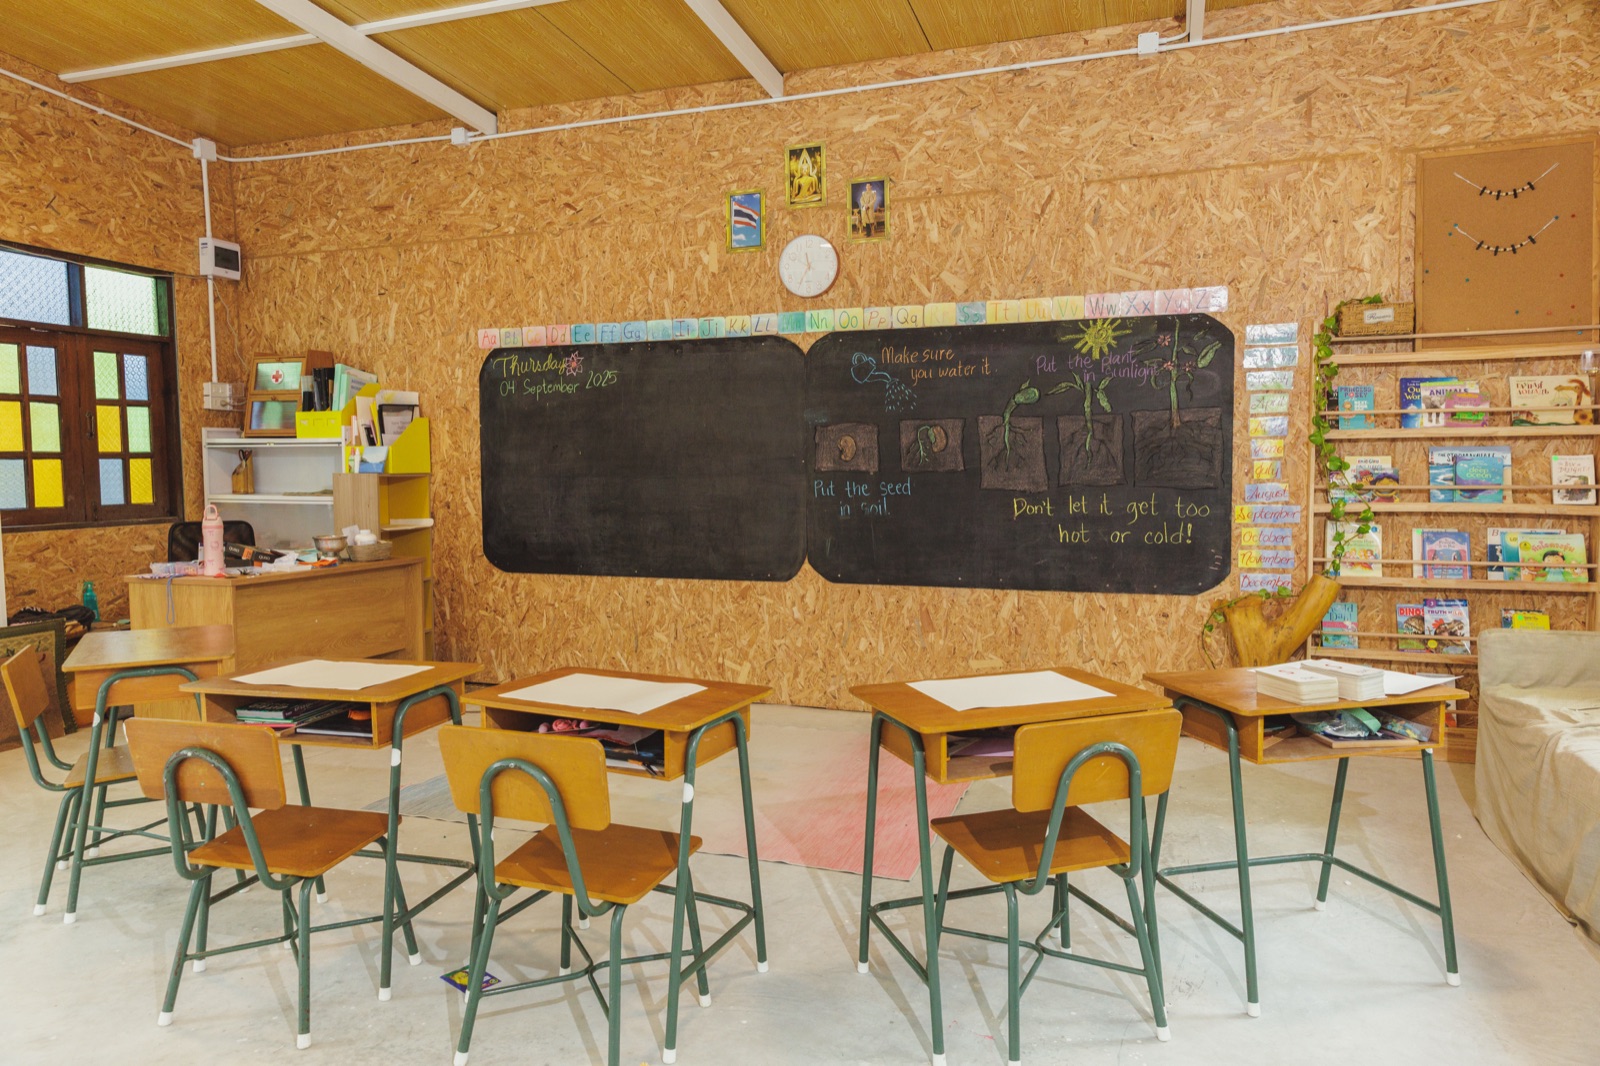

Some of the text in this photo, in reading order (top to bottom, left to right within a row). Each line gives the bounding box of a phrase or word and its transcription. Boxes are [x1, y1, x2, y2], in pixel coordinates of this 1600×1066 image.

[482, 331, 497, 345] Aa
[504, 331, 519, 344] Bb
[526, 330, 541, 344] Cc
[551, 327, 567, 343] Dd
[574, 325, 590, 342] Ee
[601, 323, 617, 342] Ff
[623, 323, 641, 341] Gg
[675, 319, 690, 337] Ii
[703, 319, 718, 337] Jj
[729, 317, 747, 334] Kk
[810, 312, 828, 329] Nn
[838, 310, 858, 329] Oo
[868, 311, 886, 328] Pp
[896, 307, 918, 328] Qq
[959, 305, 983, 323] Ss
[991, 302, 1009, 322] Tt
[1026, 301, 1046, 320] Uu
[1057, 297, 1078, 317] Vv
[1089, 296, 1117, 316] Ww
[1126, 294, 1151, 315] Xx
[1163, 291, 1183, 314] Yy
[881, 346, 955, 364] Make sure
[1036, 345, 1138, 375] Put the plant
[493, 353, 567, 378] Thursday
[910, 368, 933, 387] you
[938, 360, 976, 379] water
[500, 369, 619, 402] 04 September 2025
[1083, 370, 1096, 383] in
[1253, 440, 1283, 456] June
[1255, 461, 1279, 479] July
[814, 477, 911, 498] Put the seed
[1246, 485, 1288, 501] August
[840, 501, 851, 517] in
[1013, 492, 1210, 525] Don't let it get too
[1235, 506, 1300, 522] September
[1059, 522, 1193, 544] hot or cold!
[1242, 530, 1291, 543] October
[1240, 550, 1295, 566] November
[1240, 574, 1292, 588] December
